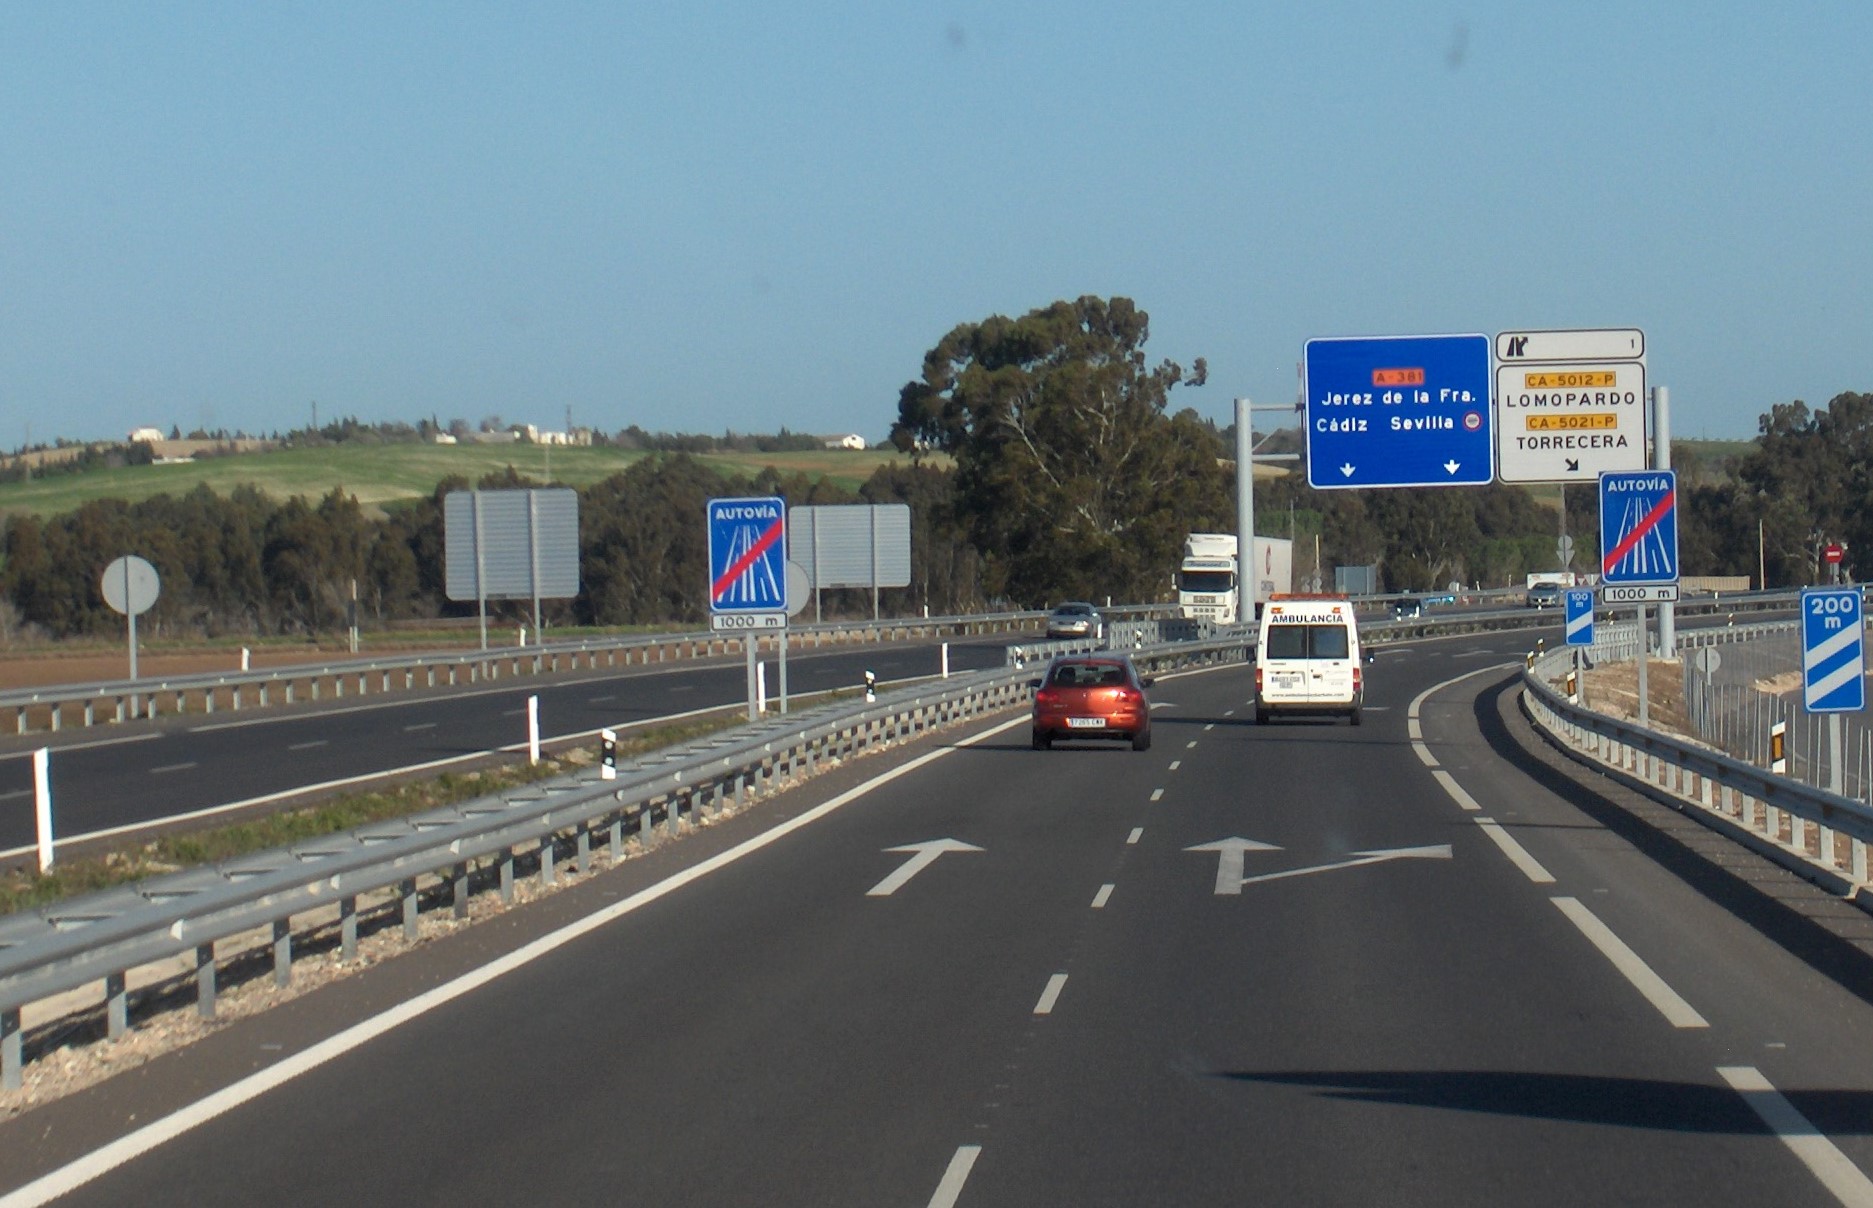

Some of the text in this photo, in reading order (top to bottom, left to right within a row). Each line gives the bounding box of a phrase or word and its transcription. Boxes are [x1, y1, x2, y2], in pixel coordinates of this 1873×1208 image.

[1376, 371, 1422, 383] A-381
[1527, 374, 1613, 387] CA-5012-P
[1321, 388, 1476, 406] Jerez de la Fra.
[1506, 391, 1635, 407] LOMOPARDO
[1316, 415, 1454, 432] Cádiz Sevilla
[1529, 416, 1614, 429] CA-5021-P
[1516, 434, 1628, 450] TORRECERA
[1607, 477, 1669, 492] AUTOVÍA
[715, 505, 778, 520] AUTOVÍA
[1571, 593, 1588, 601] 100
[1612, 588, 1670, 600] 1000 m
[1811, 596, 1853, 615] 200
[720, 615, 778, 627] 1000 m
[1271, 614, 1344, 623] AMBULANCIA
[1824, 616, 1842, 629] m
